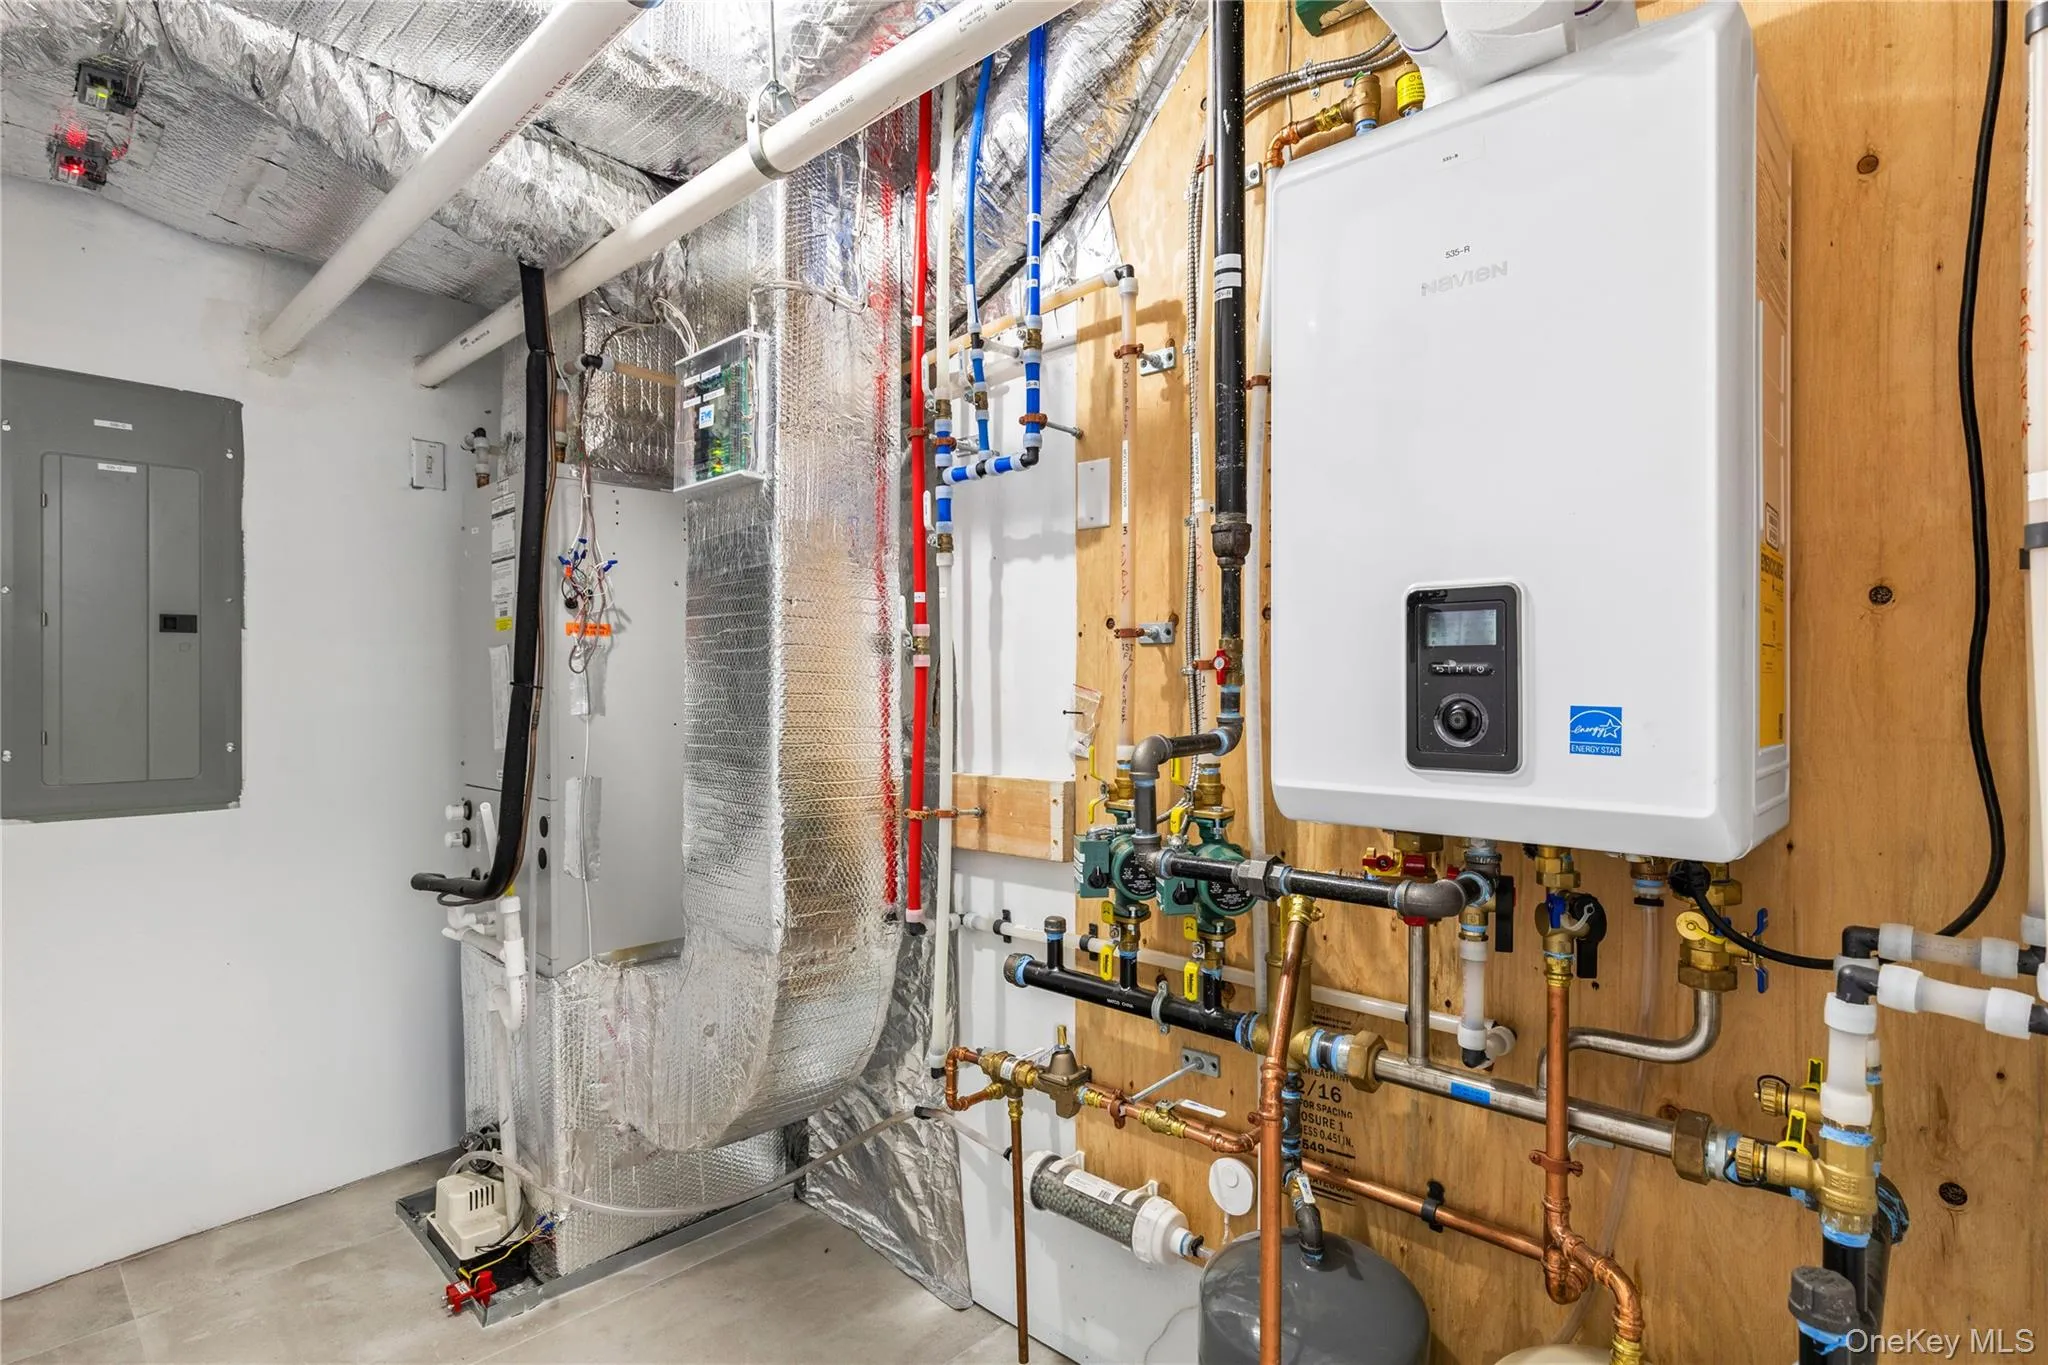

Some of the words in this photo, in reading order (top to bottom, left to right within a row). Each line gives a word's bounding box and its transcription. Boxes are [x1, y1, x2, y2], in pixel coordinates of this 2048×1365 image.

[488, 103, 543, 154] CHARLOTTE
[545, 71, 575, 99] PIPE
[1445, 245, 1471, 259] 535-R
[1571, 744, 1601, 754] ENERGY
[1601, 746, 1621, 755] STAR
[1338, 1121, 1345, 1132] 1
